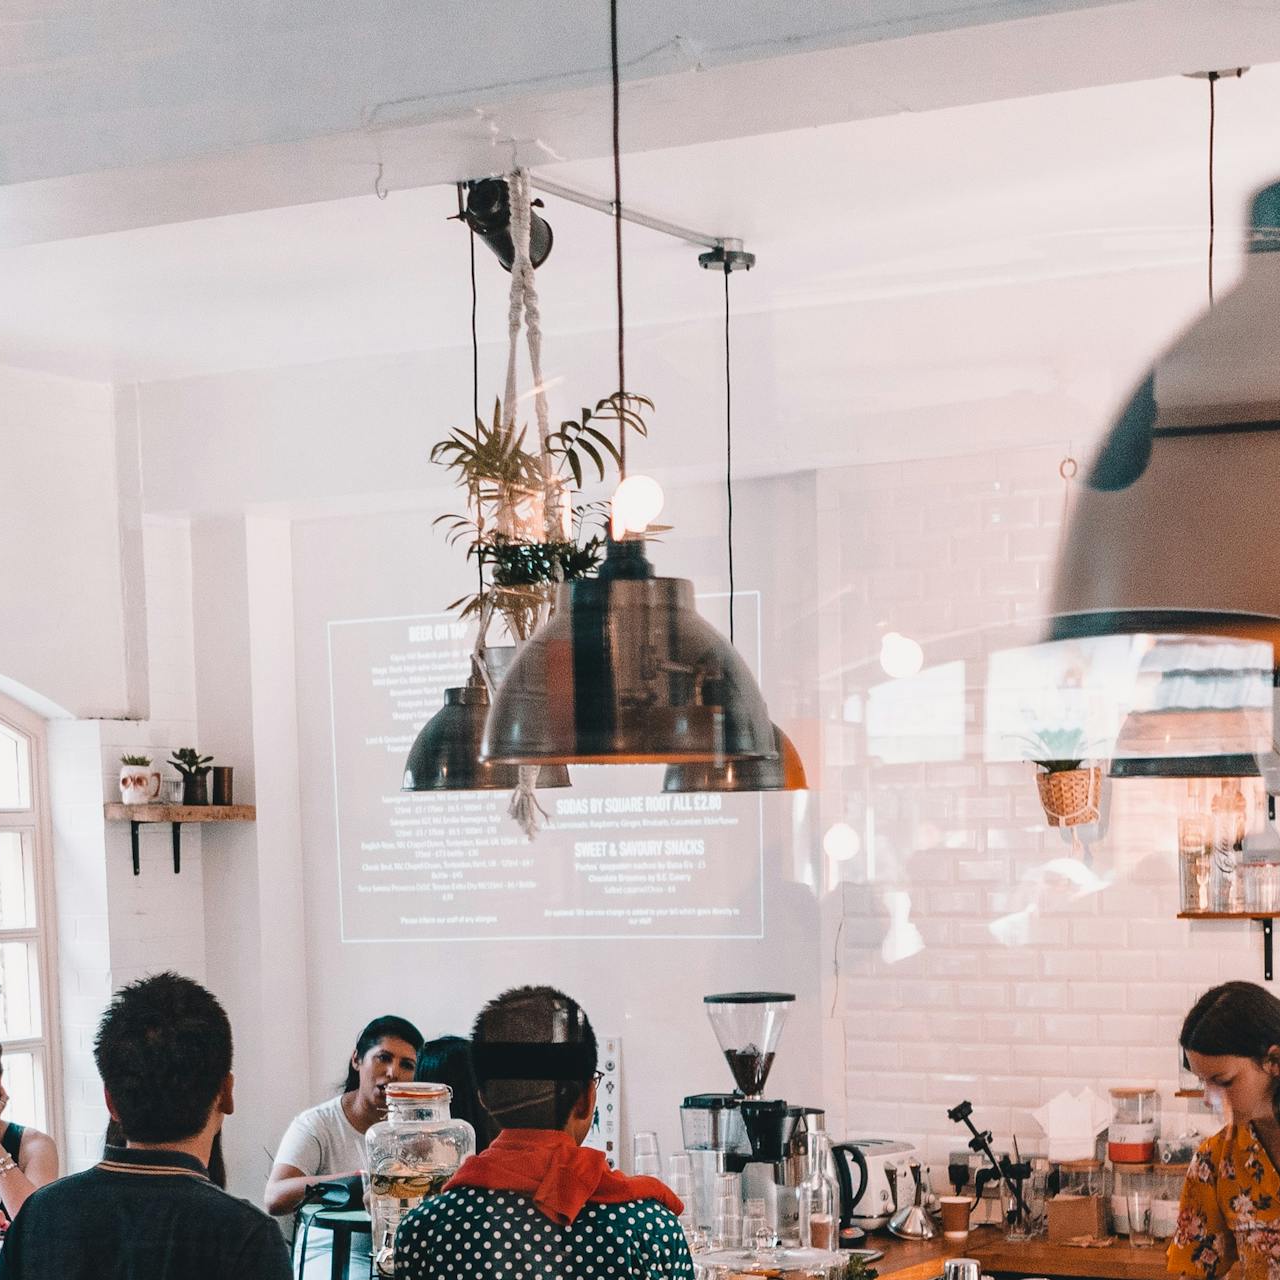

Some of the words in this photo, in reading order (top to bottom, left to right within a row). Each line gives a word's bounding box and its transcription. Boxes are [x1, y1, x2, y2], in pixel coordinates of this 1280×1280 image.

[556, 798, 588, 816] SODAS
[590, 797, 603, 814] BY
[604, 795, 644, 814] SQUARE
[645, 795, 671, 812] ROOT
[672, 794, 692, 812] ALL
[574, 841, 608, 858] SWEET
[608, 841, 617, 857] &
[618, 839, 662, 857] SAVOURY
[663, 838, 705, 856] SNACKS
